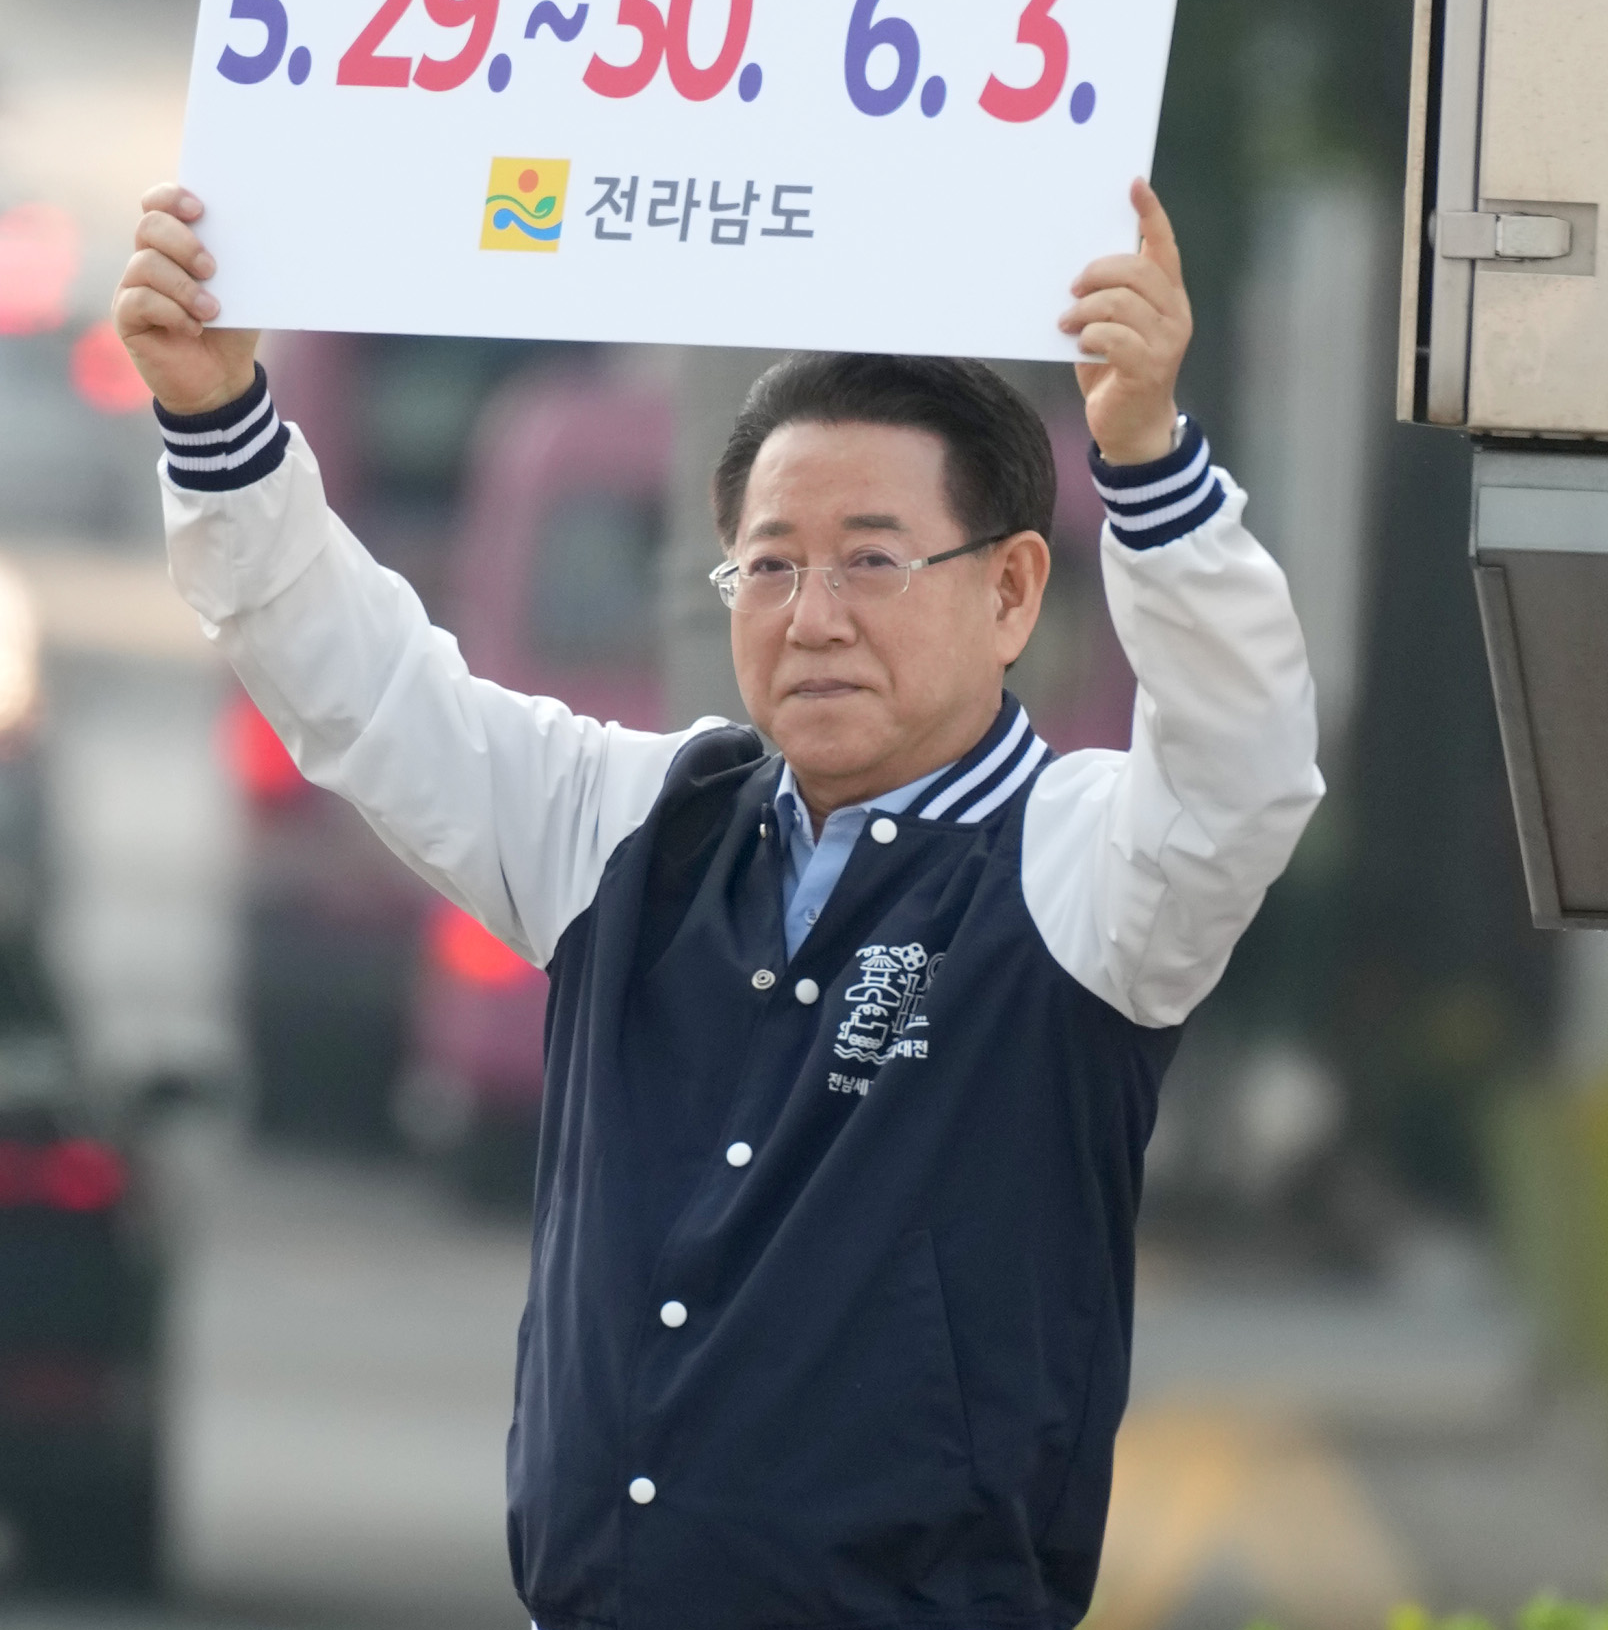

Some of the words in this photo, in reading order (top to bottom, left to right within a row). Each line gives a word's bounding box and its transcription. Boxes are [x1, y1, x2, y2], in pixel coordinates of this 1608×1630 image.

[586, 175, 814, 245] 전라남도
[893, 1039, 929, 1059] 대전
[828, 1072, 875, 1096] 전남세
